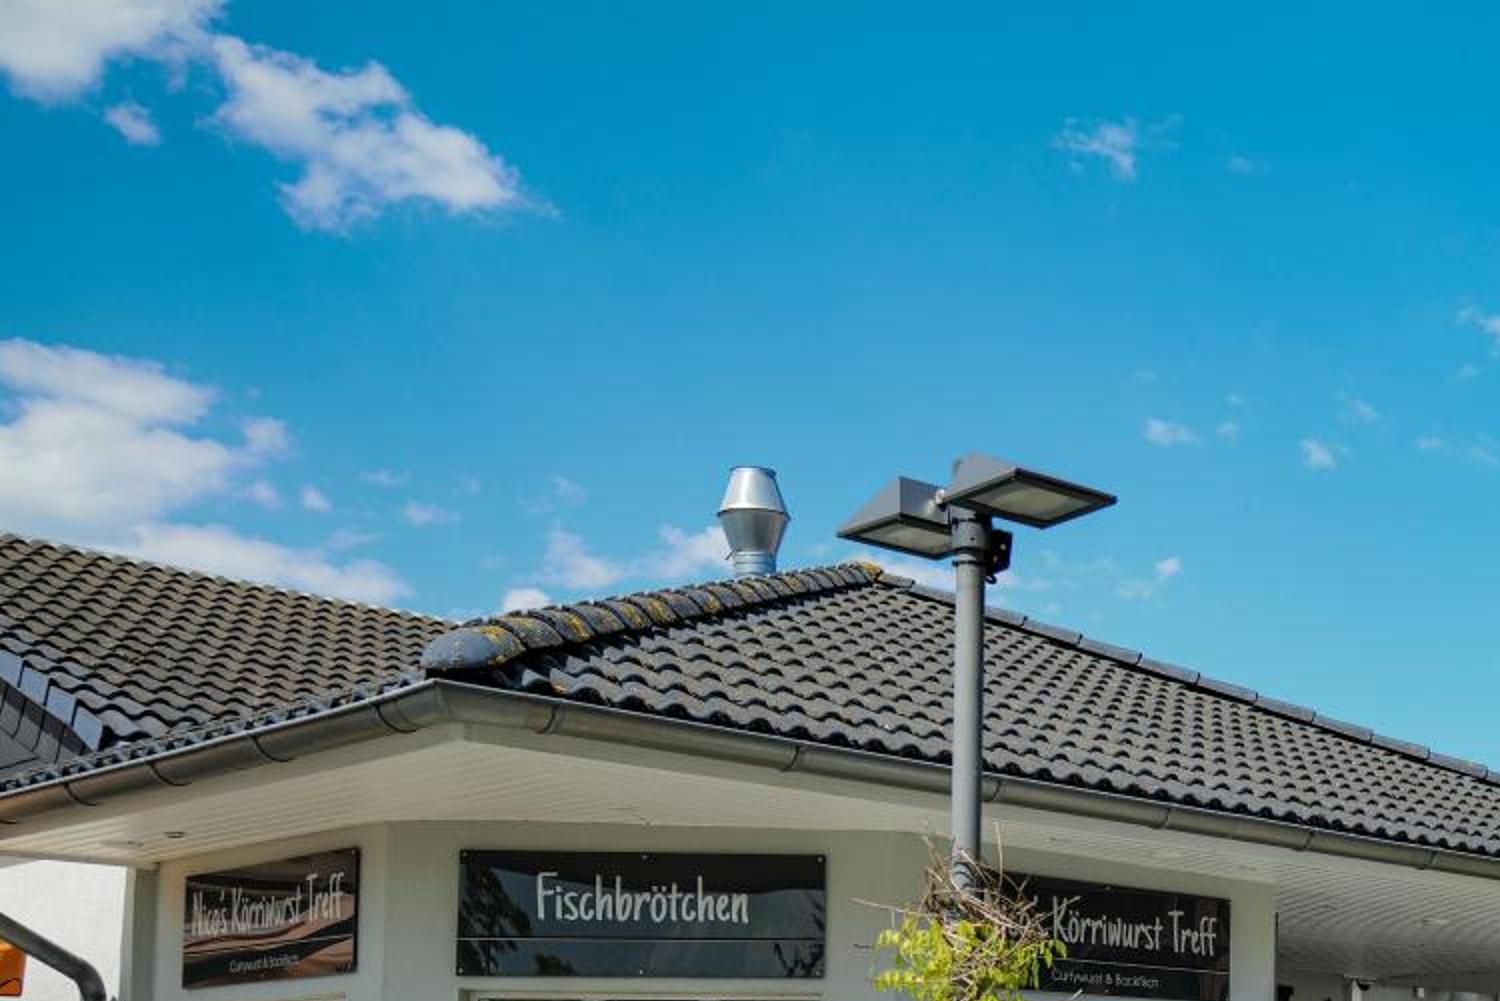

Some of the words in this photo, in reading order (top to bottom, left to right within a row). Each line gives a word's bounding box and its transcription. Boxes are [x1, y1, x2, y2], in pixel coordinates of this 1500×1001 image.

[192, 888, 227, 937] Nico's
[231, 885, 302, 934] Körriwurst
[305, 871, 345, 923] Treff
[536, 871, 750, 924] Fischbrötchen
[1053, 895, 1163, 951] Körriwurst
[1168, 909, 1217, 957] Treff
